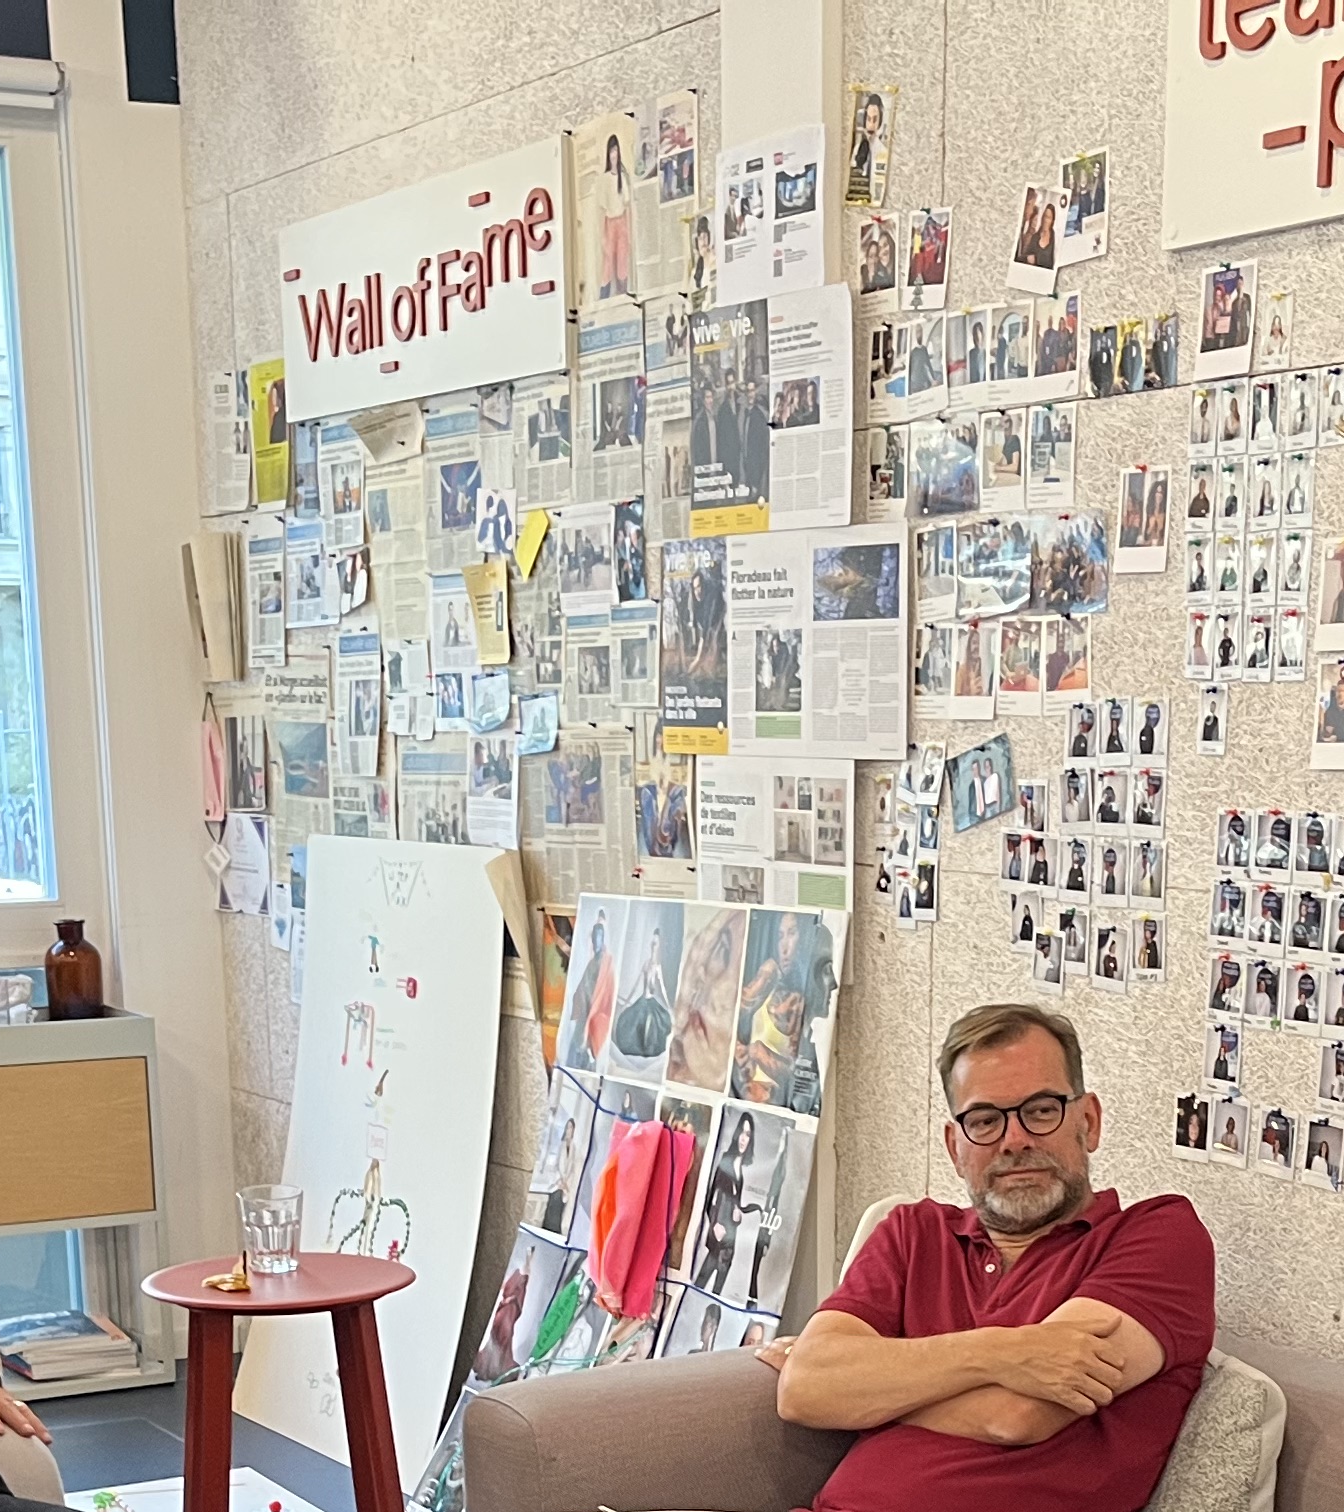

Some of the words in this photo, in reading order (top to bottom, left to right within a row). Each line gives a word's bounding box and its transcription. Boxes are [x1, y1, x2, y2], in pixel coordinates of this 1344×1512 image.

[298, 273, 384, 362] Wall
[391, 257, 431, 342] of
[437, 187, 553, 332] Fame
